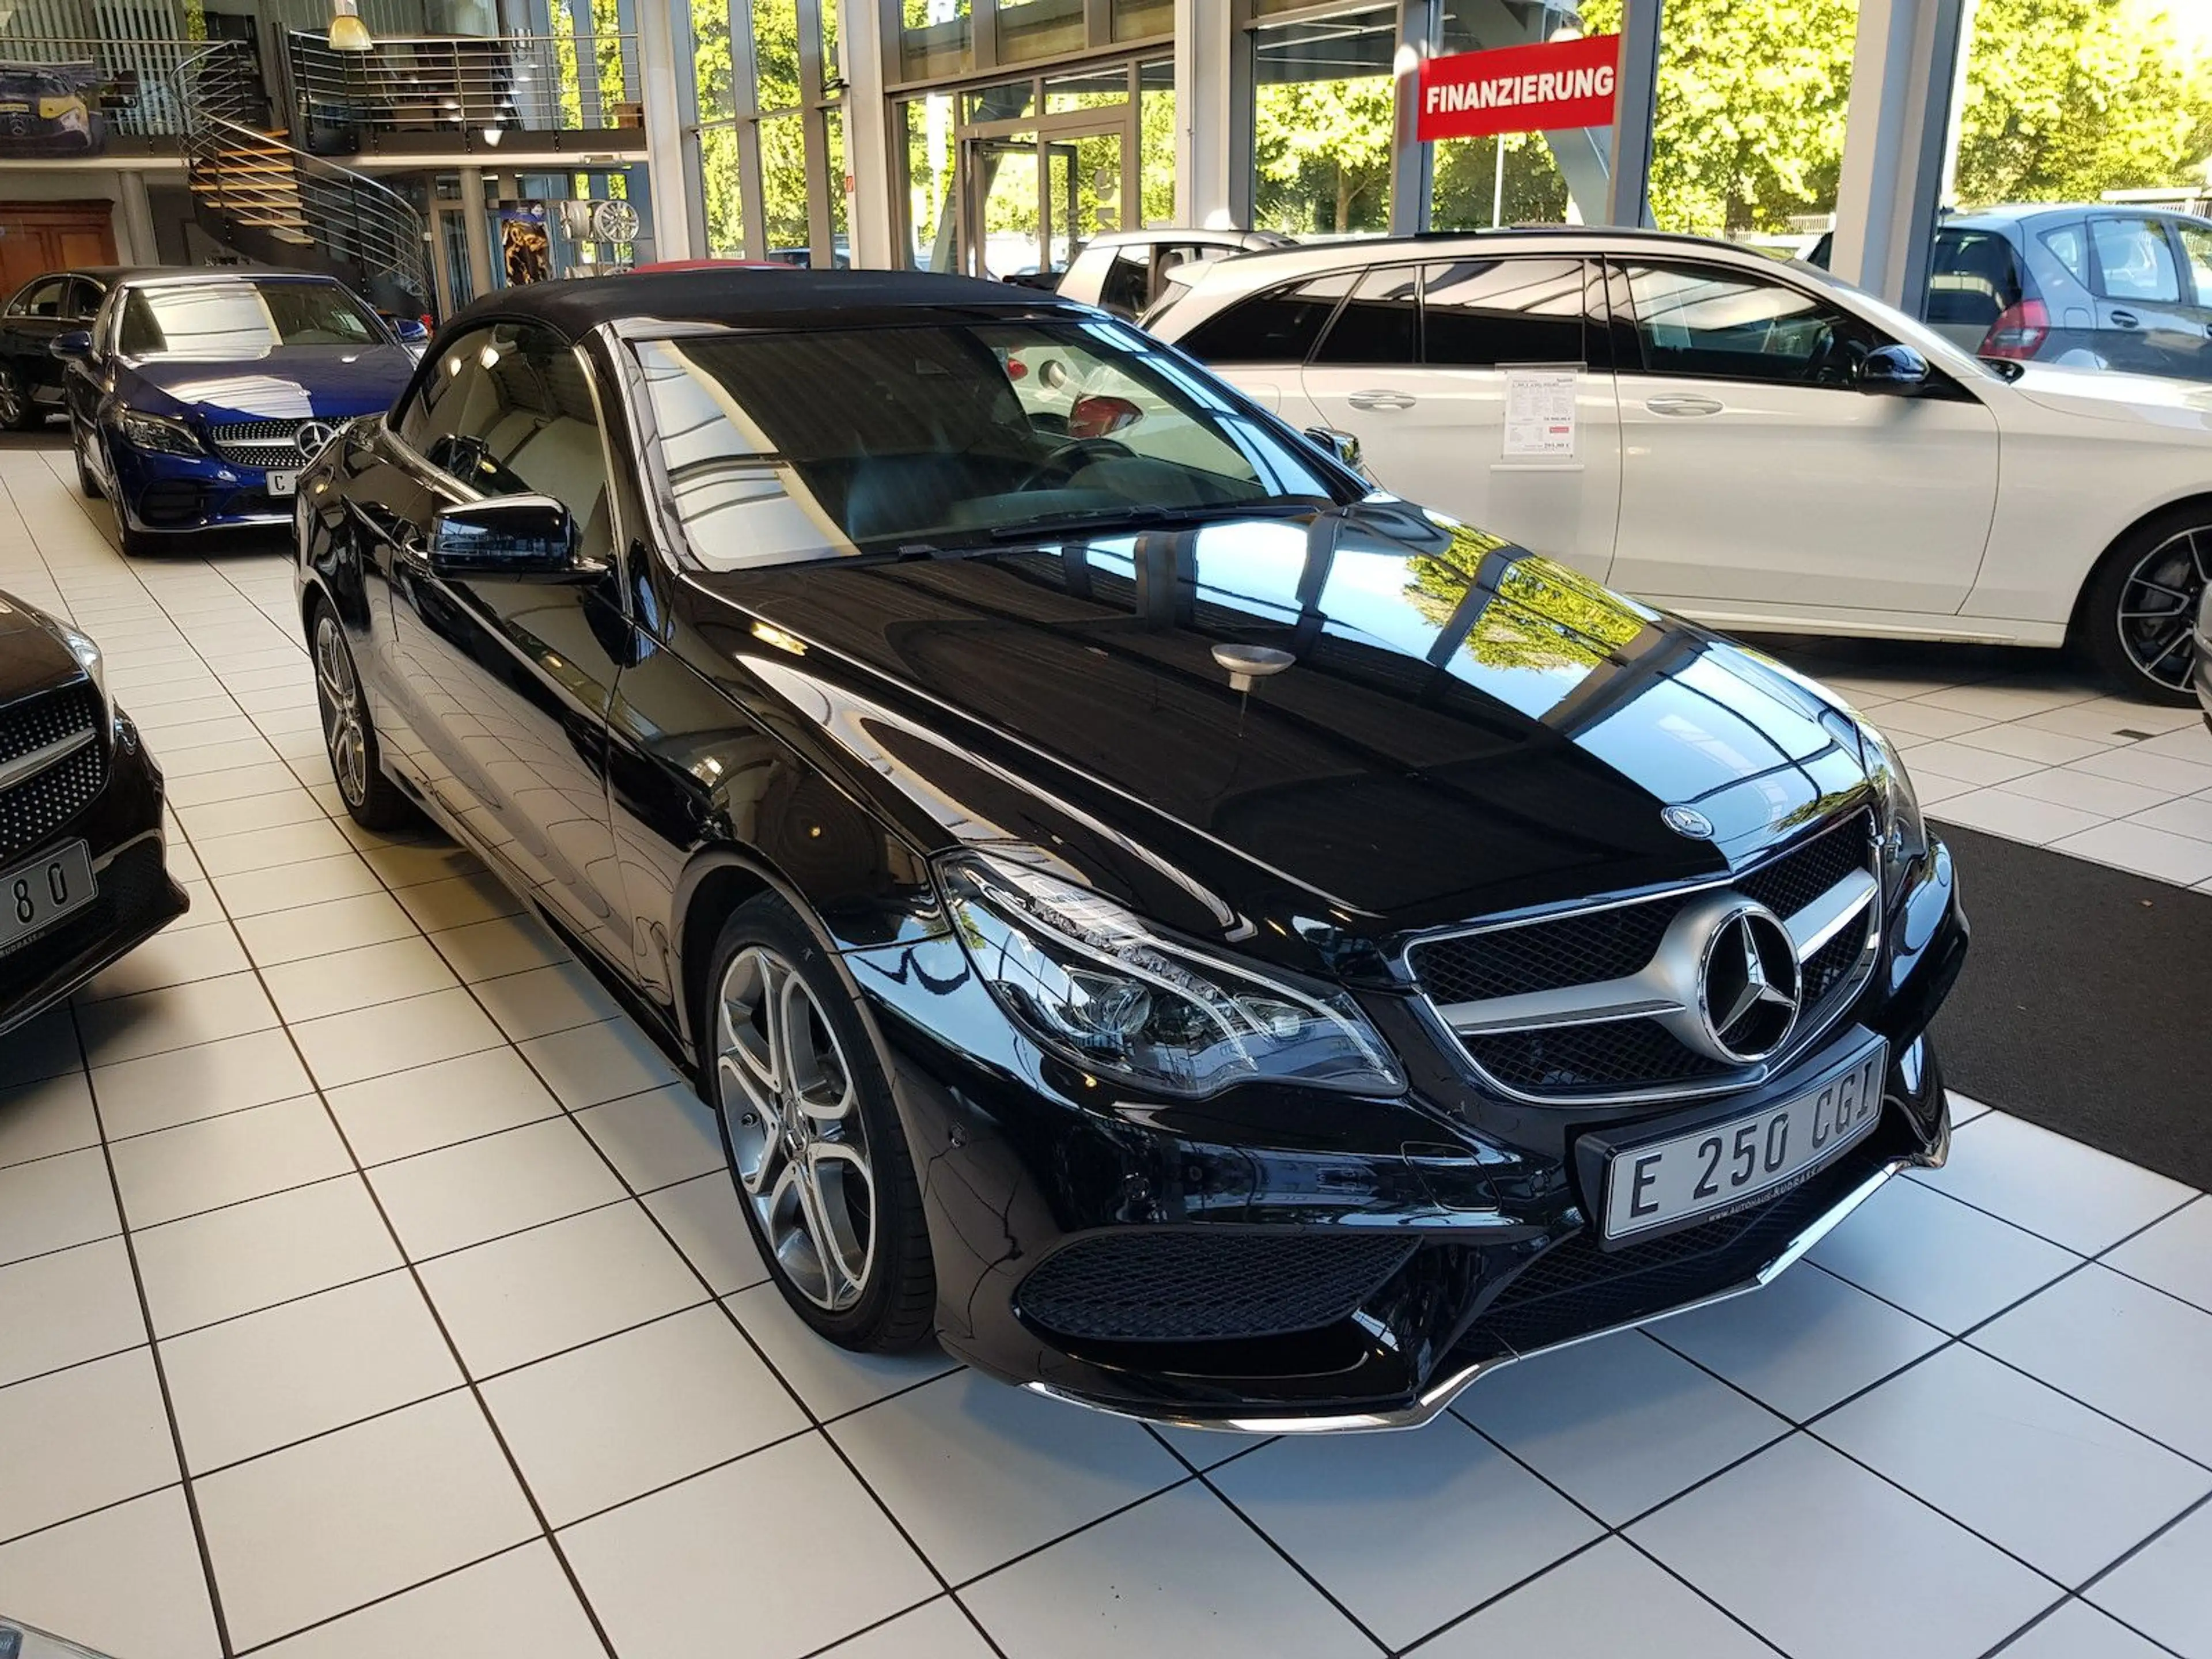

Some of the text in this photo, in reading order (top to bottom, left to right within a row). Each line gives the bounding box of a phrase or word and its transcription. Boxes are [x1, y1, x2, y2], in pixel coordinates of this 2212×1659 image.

[1426, 65, 1614, 115] FINANZIERUNG
[275, 475, 285, 491] C
[1631, 1061, 1872, 1218] E 250 CGI
